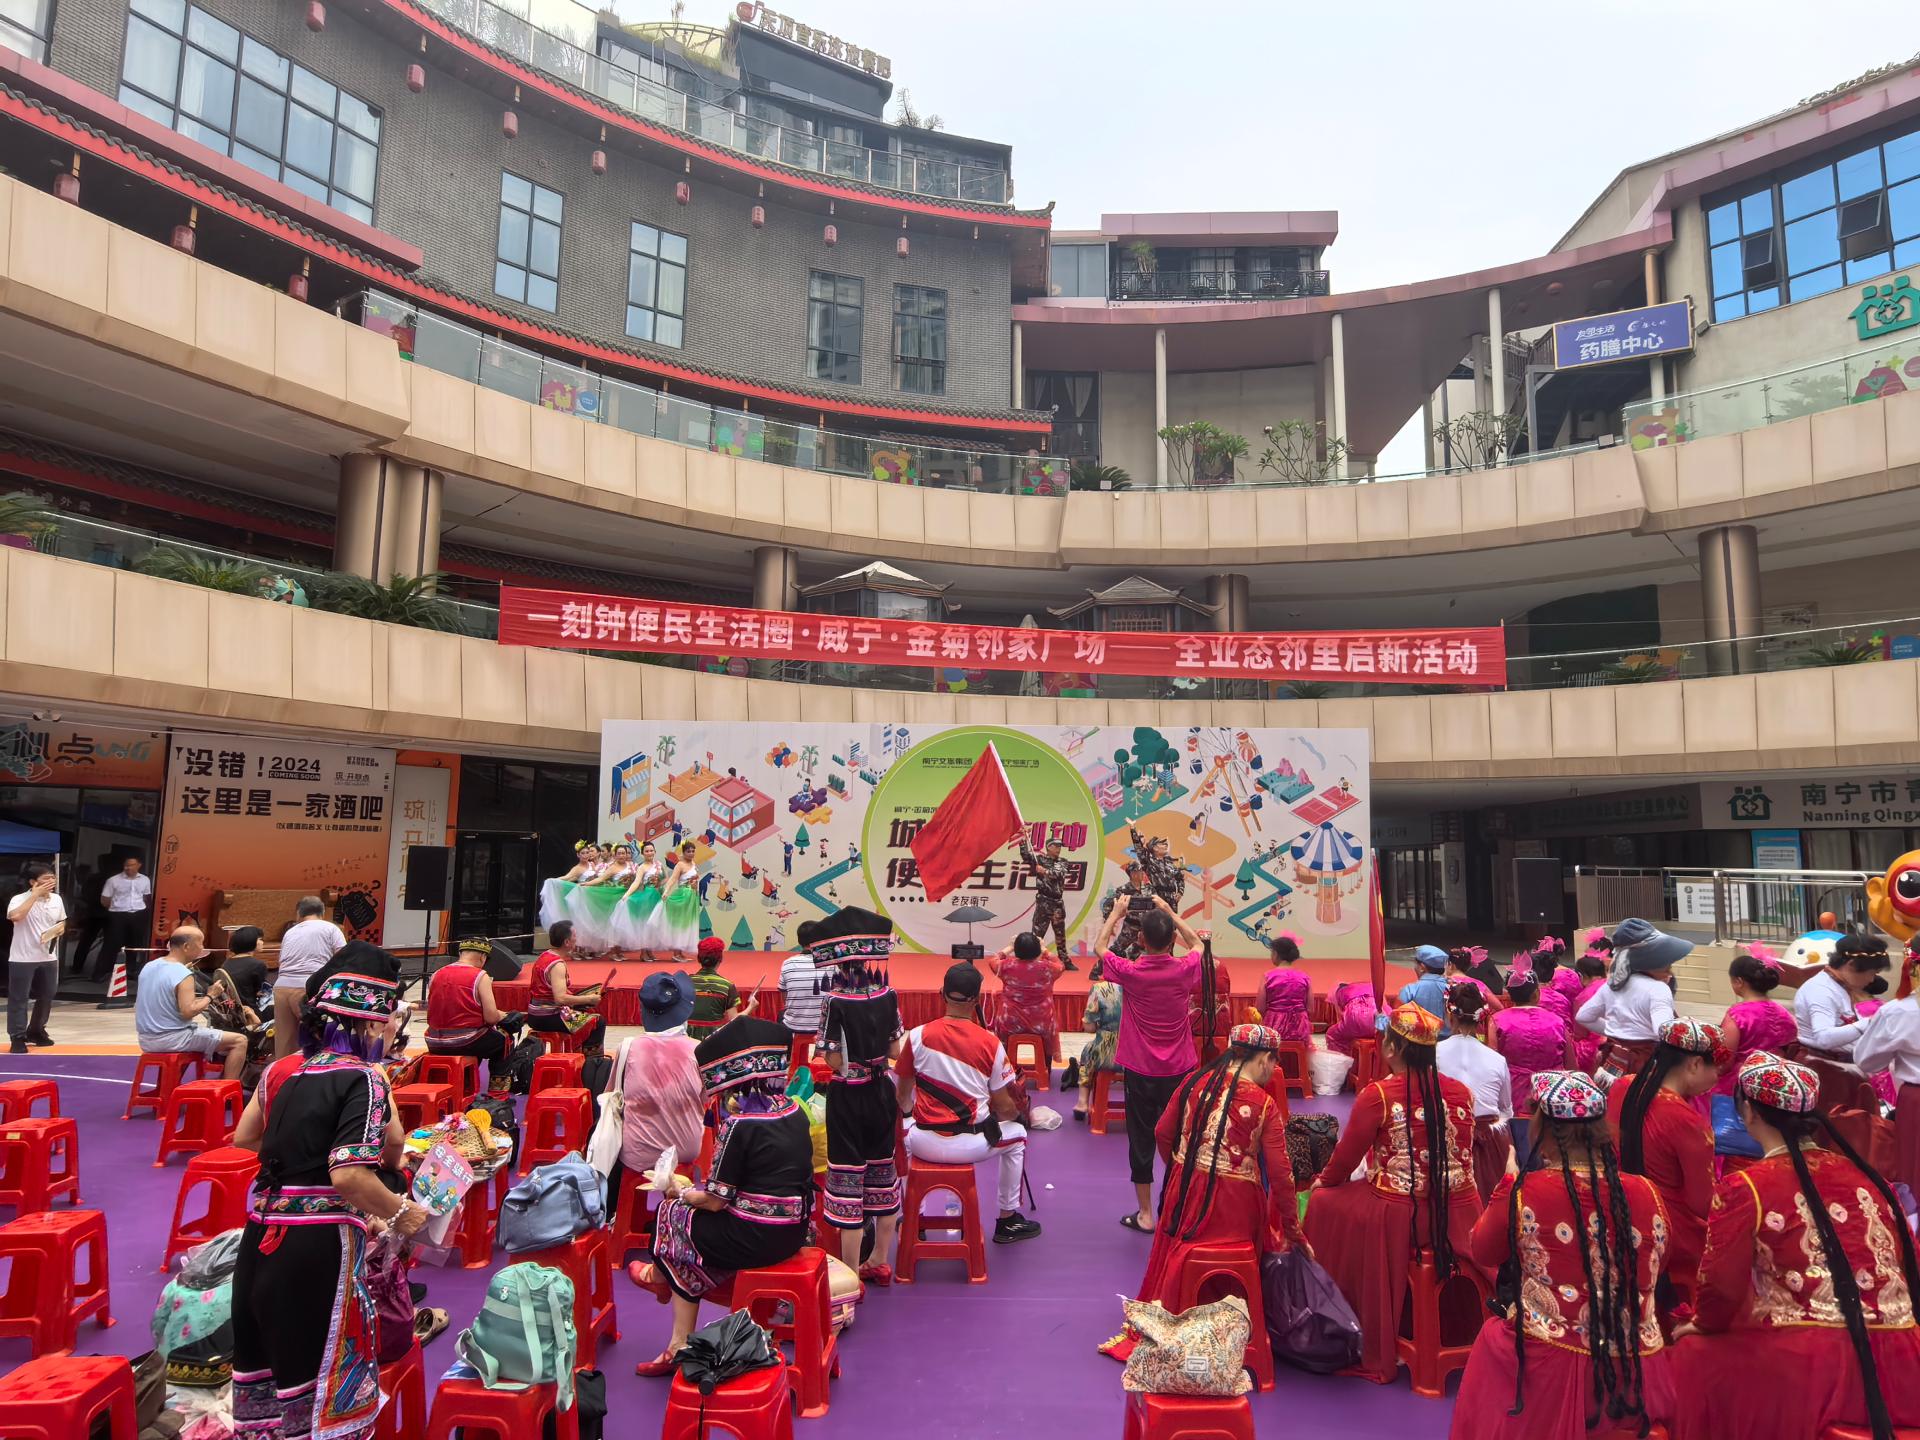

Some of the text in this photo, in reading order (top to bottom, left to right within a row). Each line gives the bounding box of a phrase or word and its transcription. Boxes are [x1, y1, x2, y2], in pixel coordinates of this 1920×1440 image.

[1579, 332, 1664, 360] 药膳中心
[271, 756, 321, 773] 2024
[269, 770, 321, 780] COMING SOON
[181, 787, 384, 820] 这里是一家酒吧
[1803, 810, 1871, 824] Nanning
